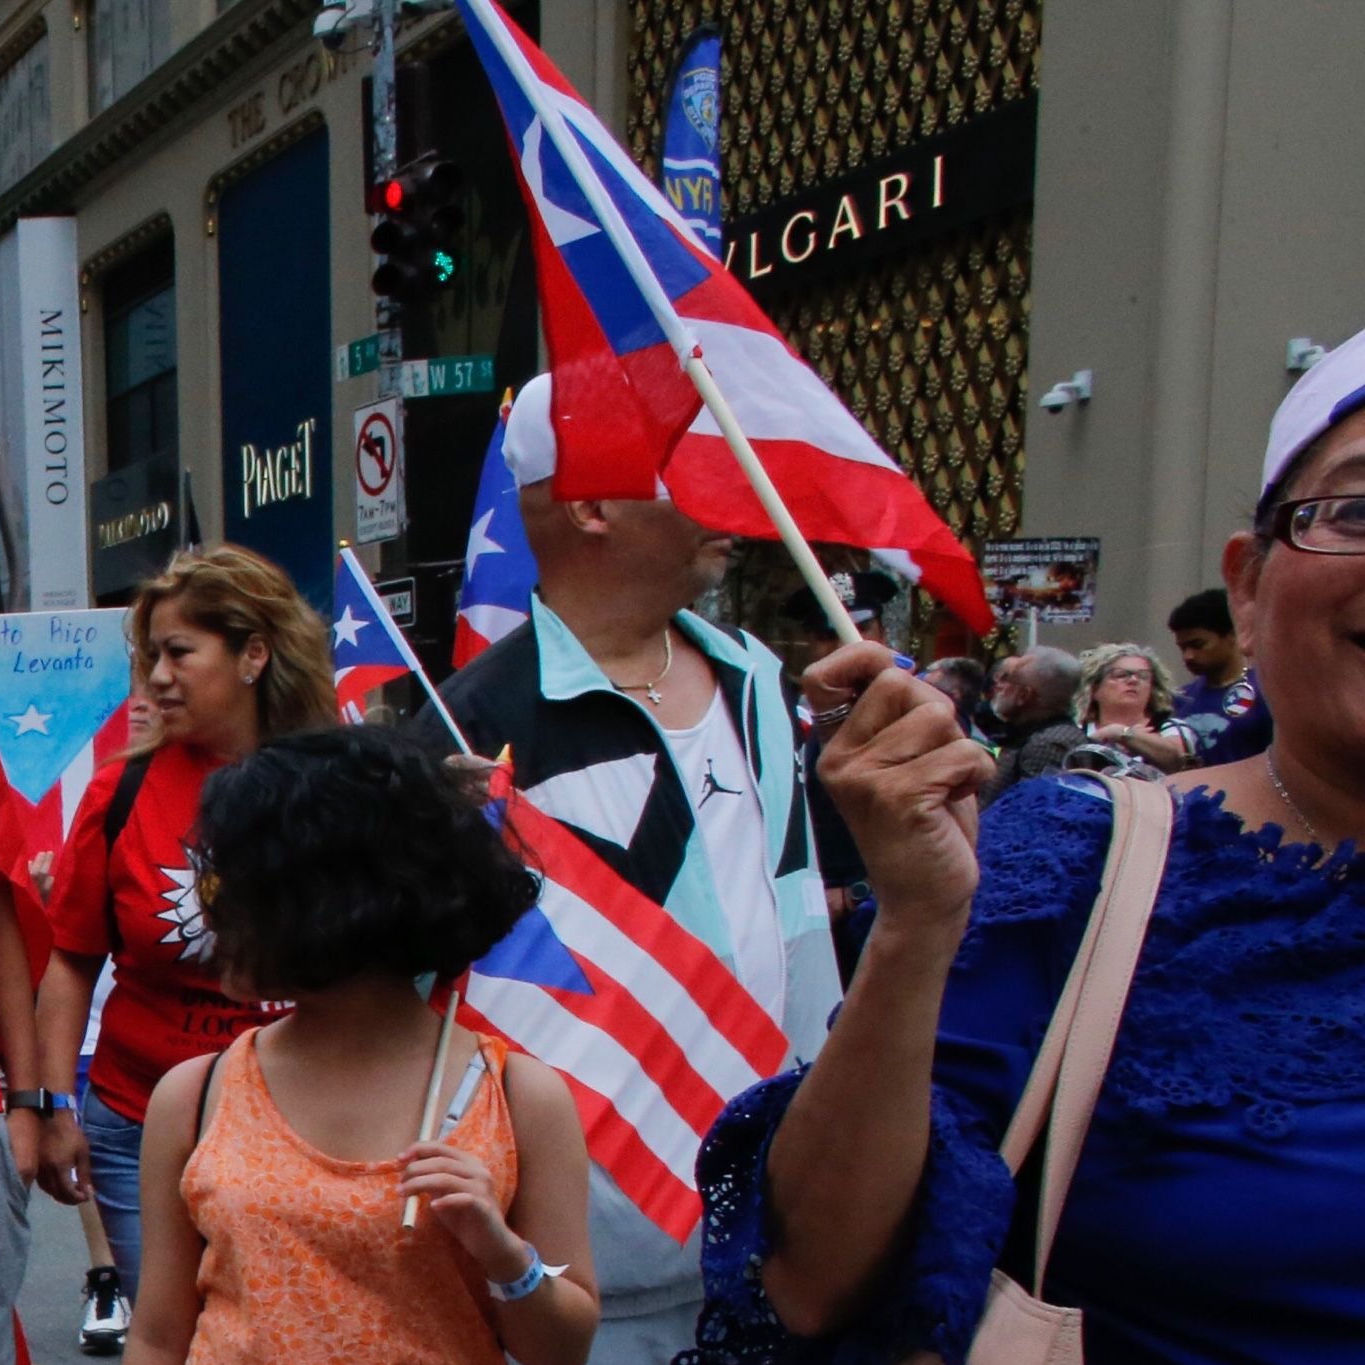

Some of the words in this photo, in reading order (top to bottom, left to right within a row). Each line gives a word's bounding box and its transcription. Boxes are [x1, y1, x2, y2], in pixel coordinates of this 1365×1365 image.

[355, 346, 363, 371] 5
[430, 364, 446, 390] W
[455, 362, 474, 389] 57
[39, 309, 69, 506] MIKIMOTO
[242, 417, 317, 519] PIAGET
[49, 616, 98, 645] Rico
[13, 647, 95, 675] Levanta
